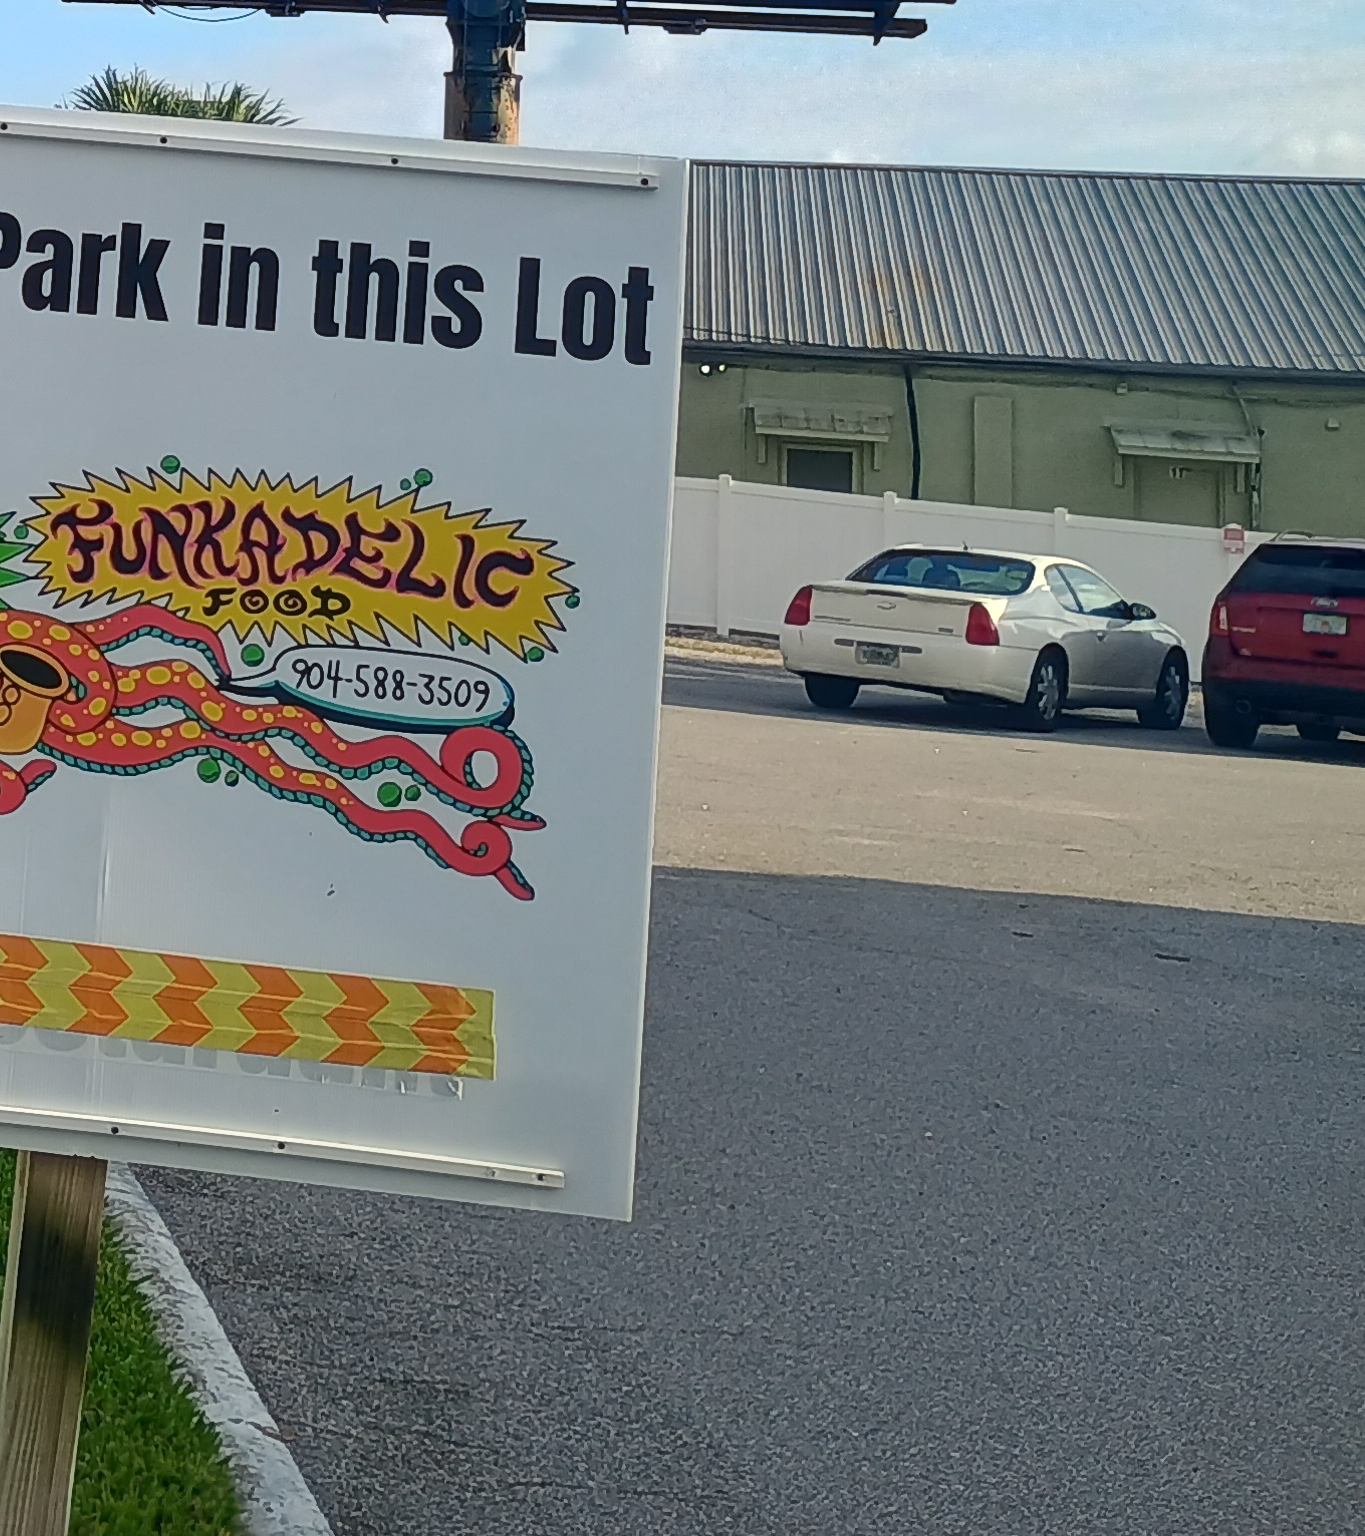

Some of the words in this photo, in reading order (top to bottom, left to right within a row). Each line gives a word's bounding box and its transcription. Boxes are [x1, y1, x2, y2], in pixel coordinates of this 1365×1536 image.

[196, 221, 279, 333] in
[310, 237, 485, 350] this
[513, 255, 655, 367] Lot
[50, 495, 535, 610] FUNKADELIC
[202, 585, 351, 619] FOOD
[290, 658, 491, 713] 904-588-3509
